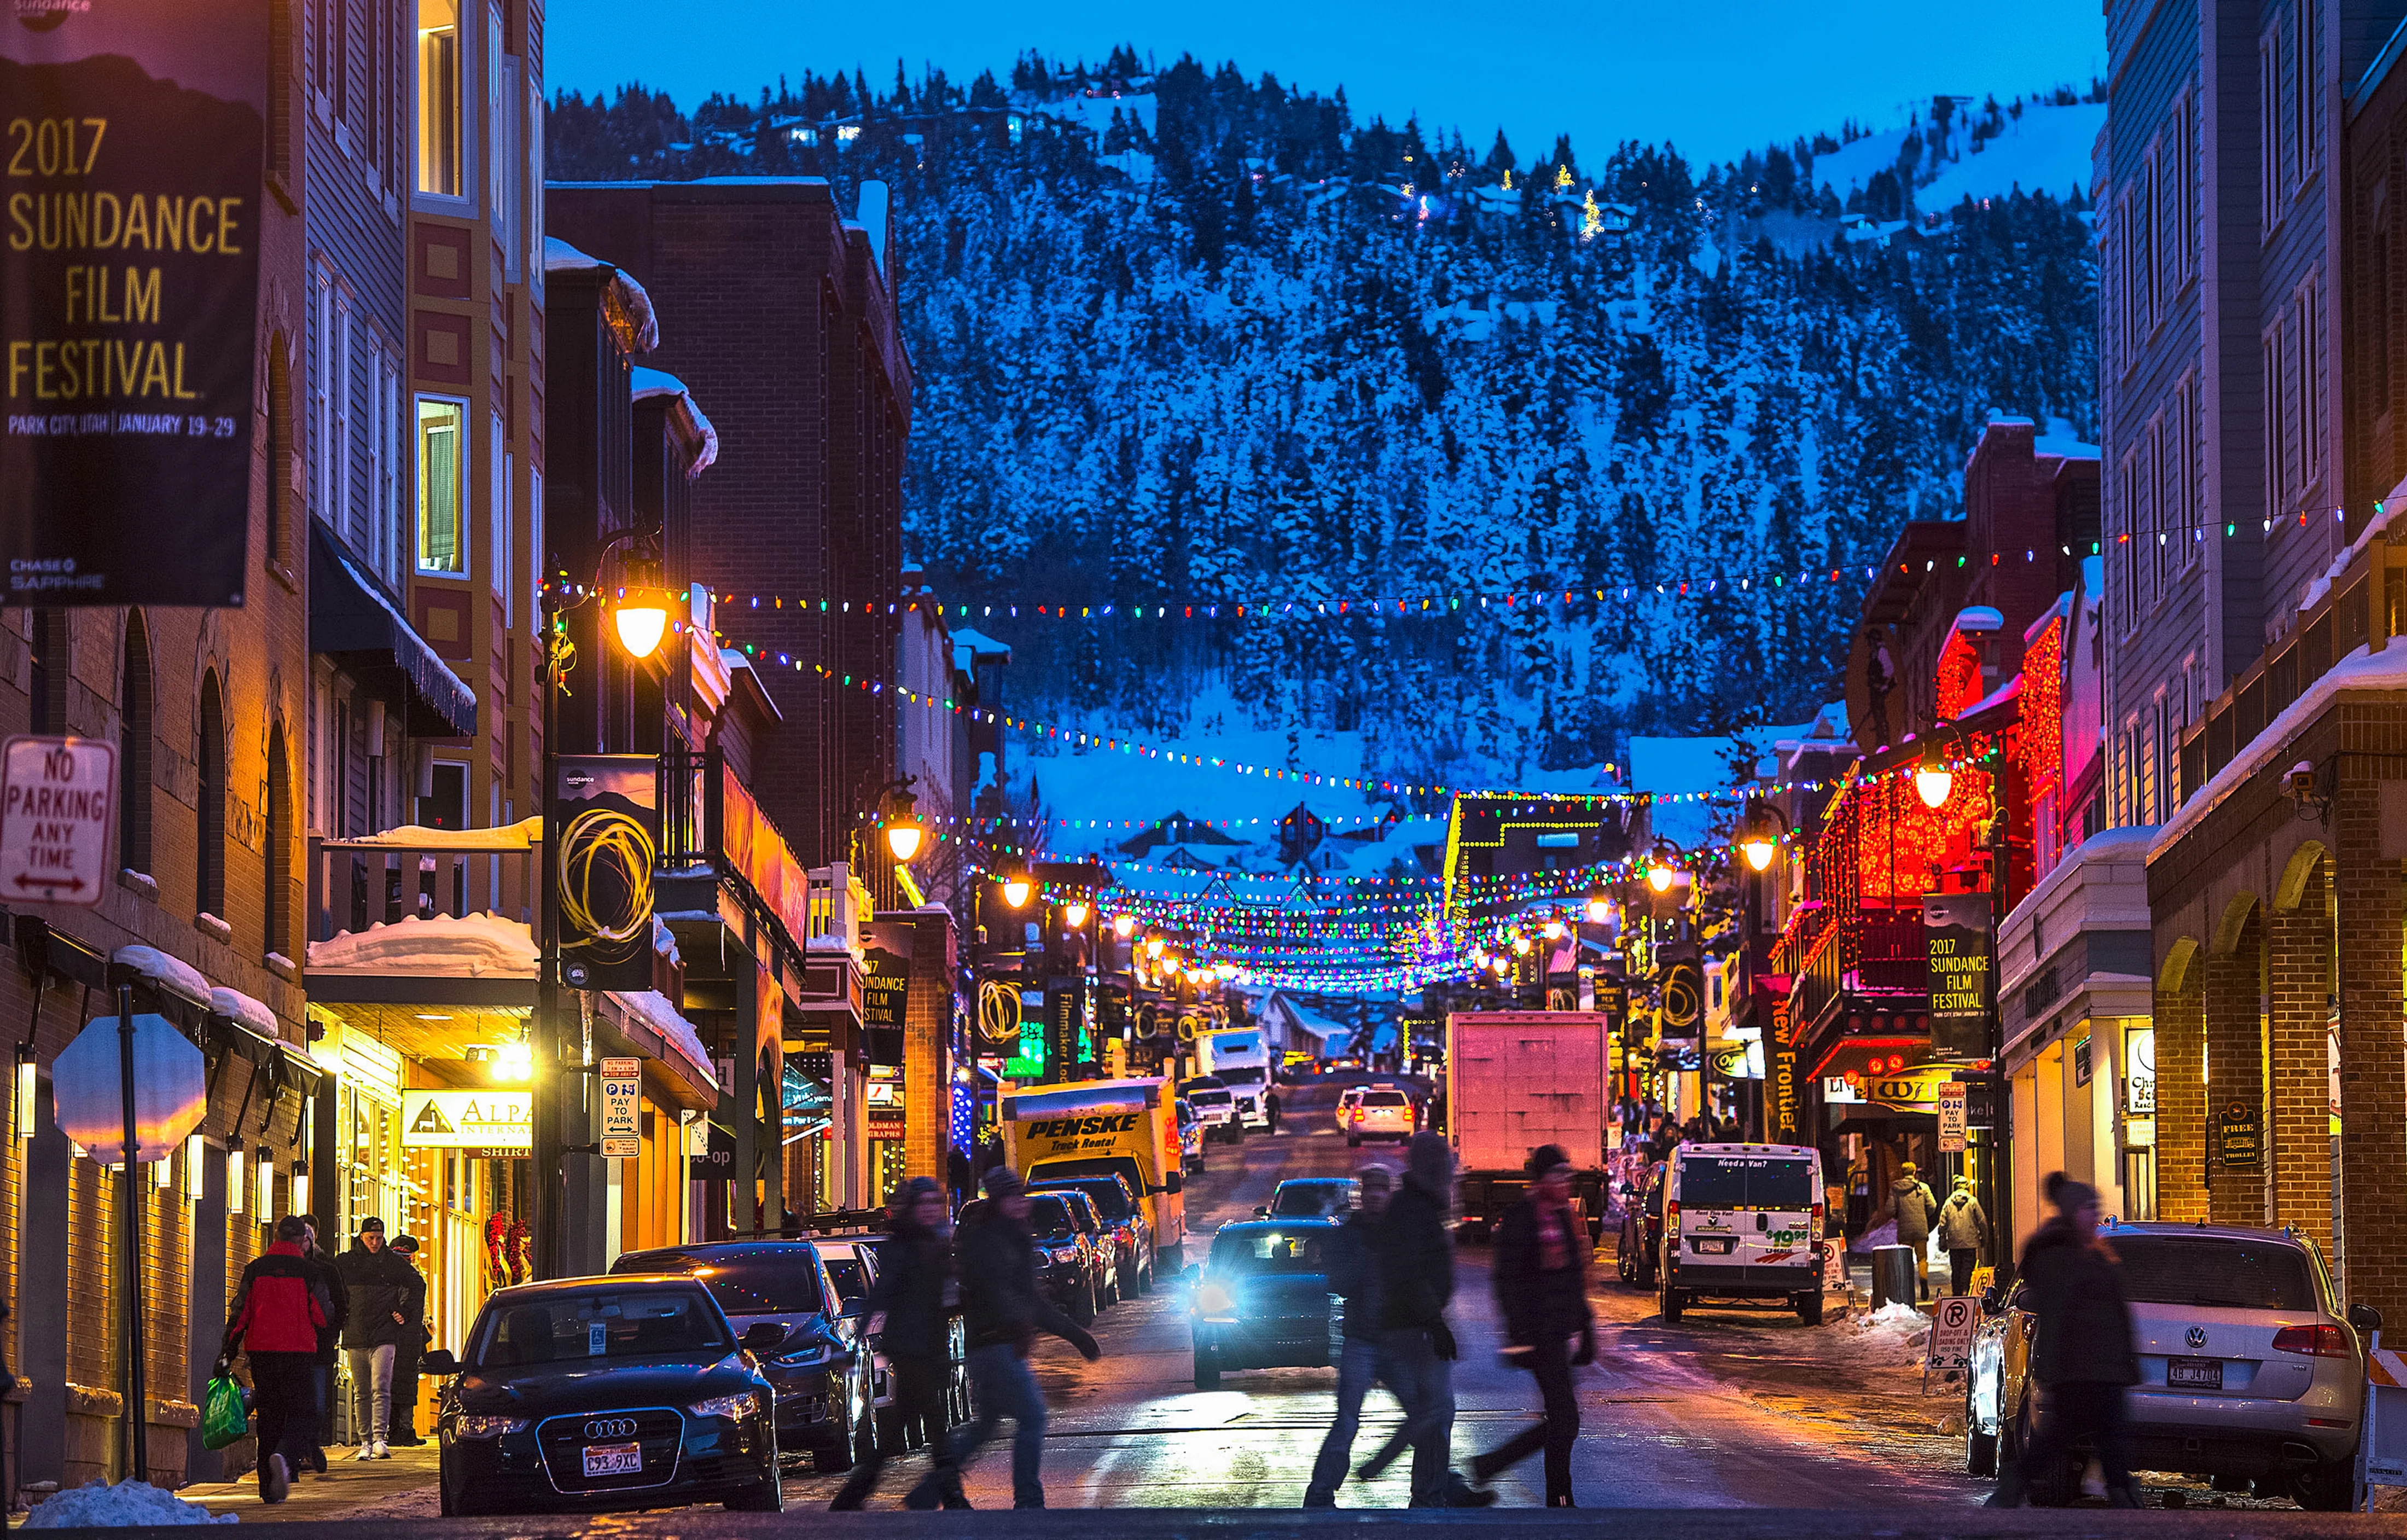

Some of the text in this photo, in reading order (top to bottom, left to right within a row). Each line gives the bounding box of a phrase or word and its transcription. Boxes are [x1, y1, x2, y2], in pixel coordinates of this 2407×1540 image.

[8, 118, 107, 176] 2017
[8, 191, 243, 255] SUNDANCE
[65, 266, 161, 325] FILM
[8, 340, 197, 400] FESTIVAL
[8, 415, 48, 435] PARK
[80, 414, 107, 434] UTAH
[118, 413, 182, 434] JANUARY
[10, 559, 60, 572] CHASE
[10, 575, 104, 589] SAPPHIRE
[43, 751, 75, 782] NO
[7, 785, 107, 821] PARKING
[32, 822, 75, 844] ANY
[30, 845, 73, 870] TIME
[1929, 938, 1956, 955] 2017
[1931, 956, 1989, 973] SUNDANCE
[1946, 974, 1972, 990] FILM
[867, 992, 888, 1006] FILM
[1933, 992, 1982, 1009] FESTIVAL
[1059, 993, 1073, 1057] Filmmaker
[1772, 1000, 1796, 1132] New Frontier
[1026, 1114, 1139, 1139] PENSKE
[2223, 1124, 2253, 1133] FREE
[1051, 1136, 1117, 1150] Truck Rental
[2173, 1368, 2218, 1381] 4B J4704
[588, 1453, 637, 1471] C93 9XC
